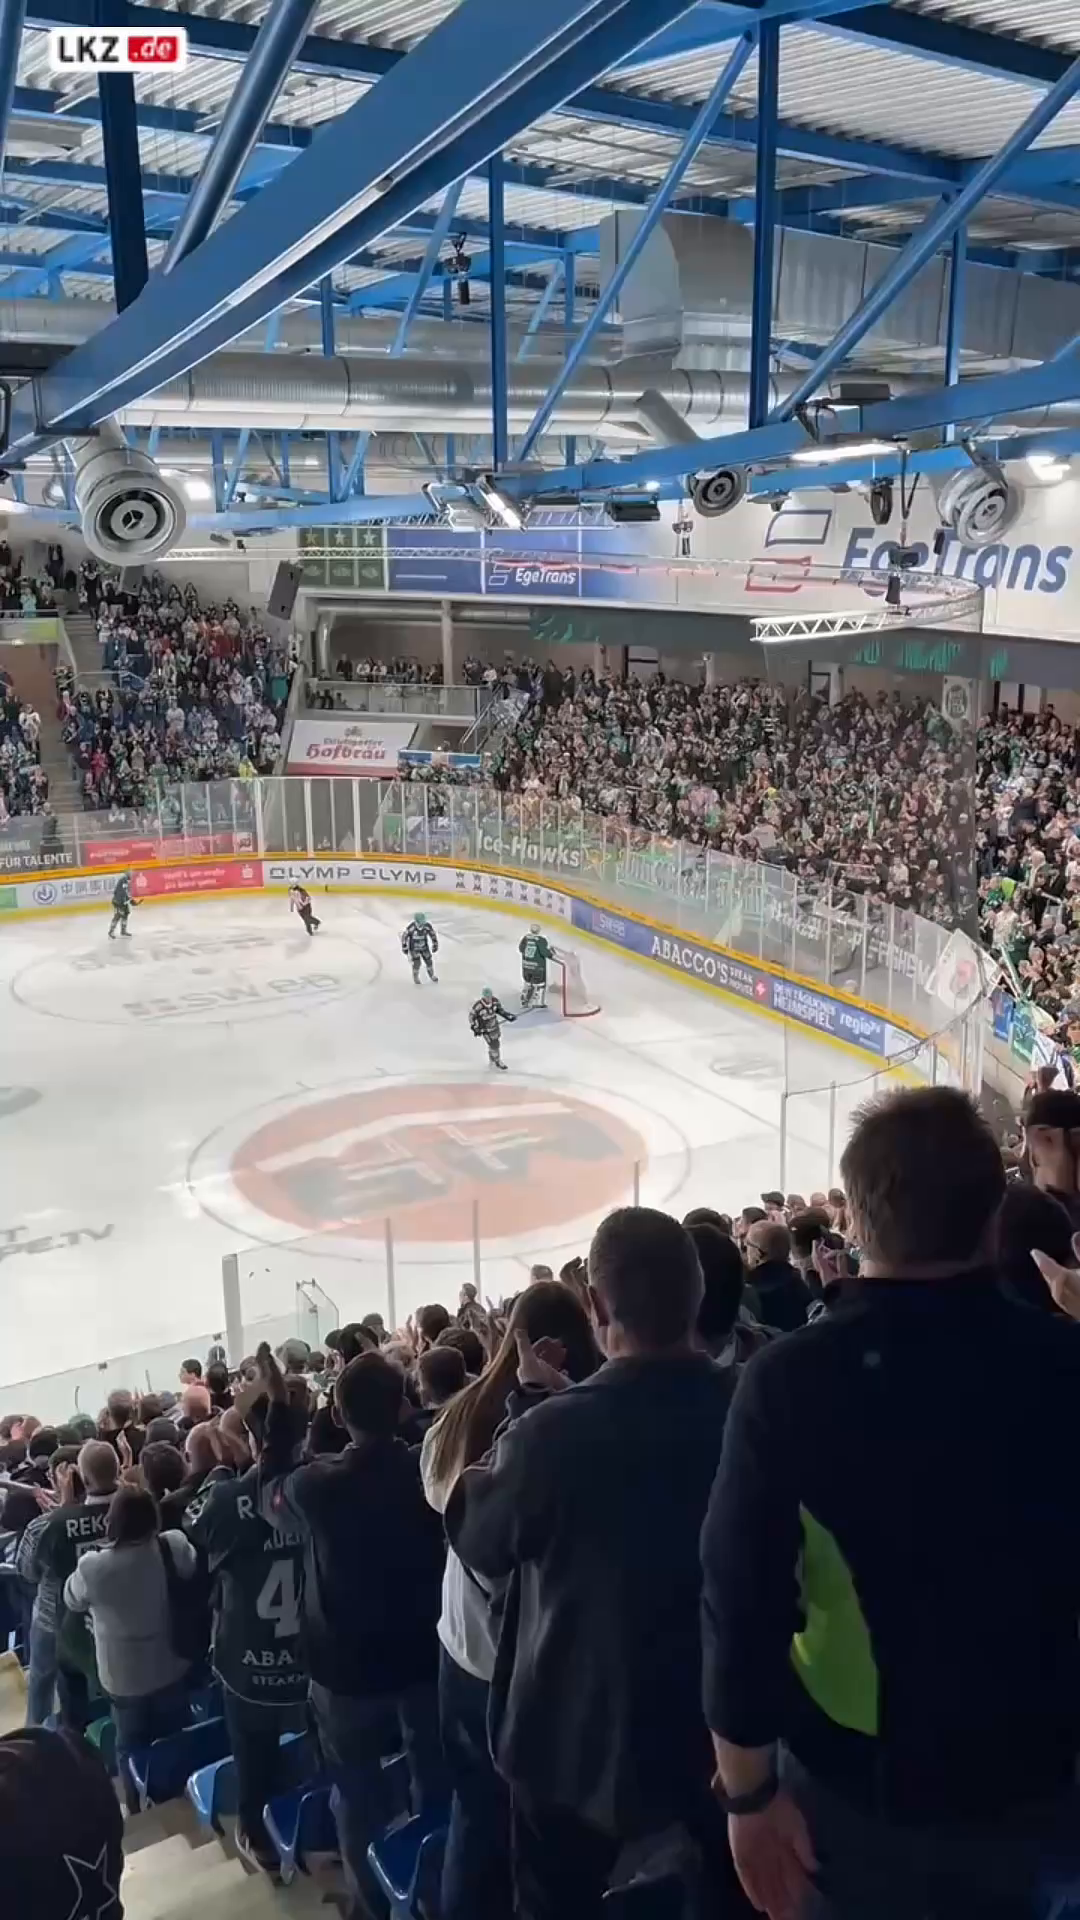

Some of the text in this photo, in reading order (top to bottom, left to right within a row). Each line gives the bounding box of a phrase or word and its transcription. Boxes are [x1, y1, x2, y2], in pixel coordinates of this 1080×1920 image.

[514, 567, 577, 586] EgeTrans
[477, 829, 580, 867] Ice-Hawks
[23, 851, 73, 867] TALENTE
[269, 866, 437, 884] OLYMP OLYMP
[651, 935, 729, 984] ABACCO'S
